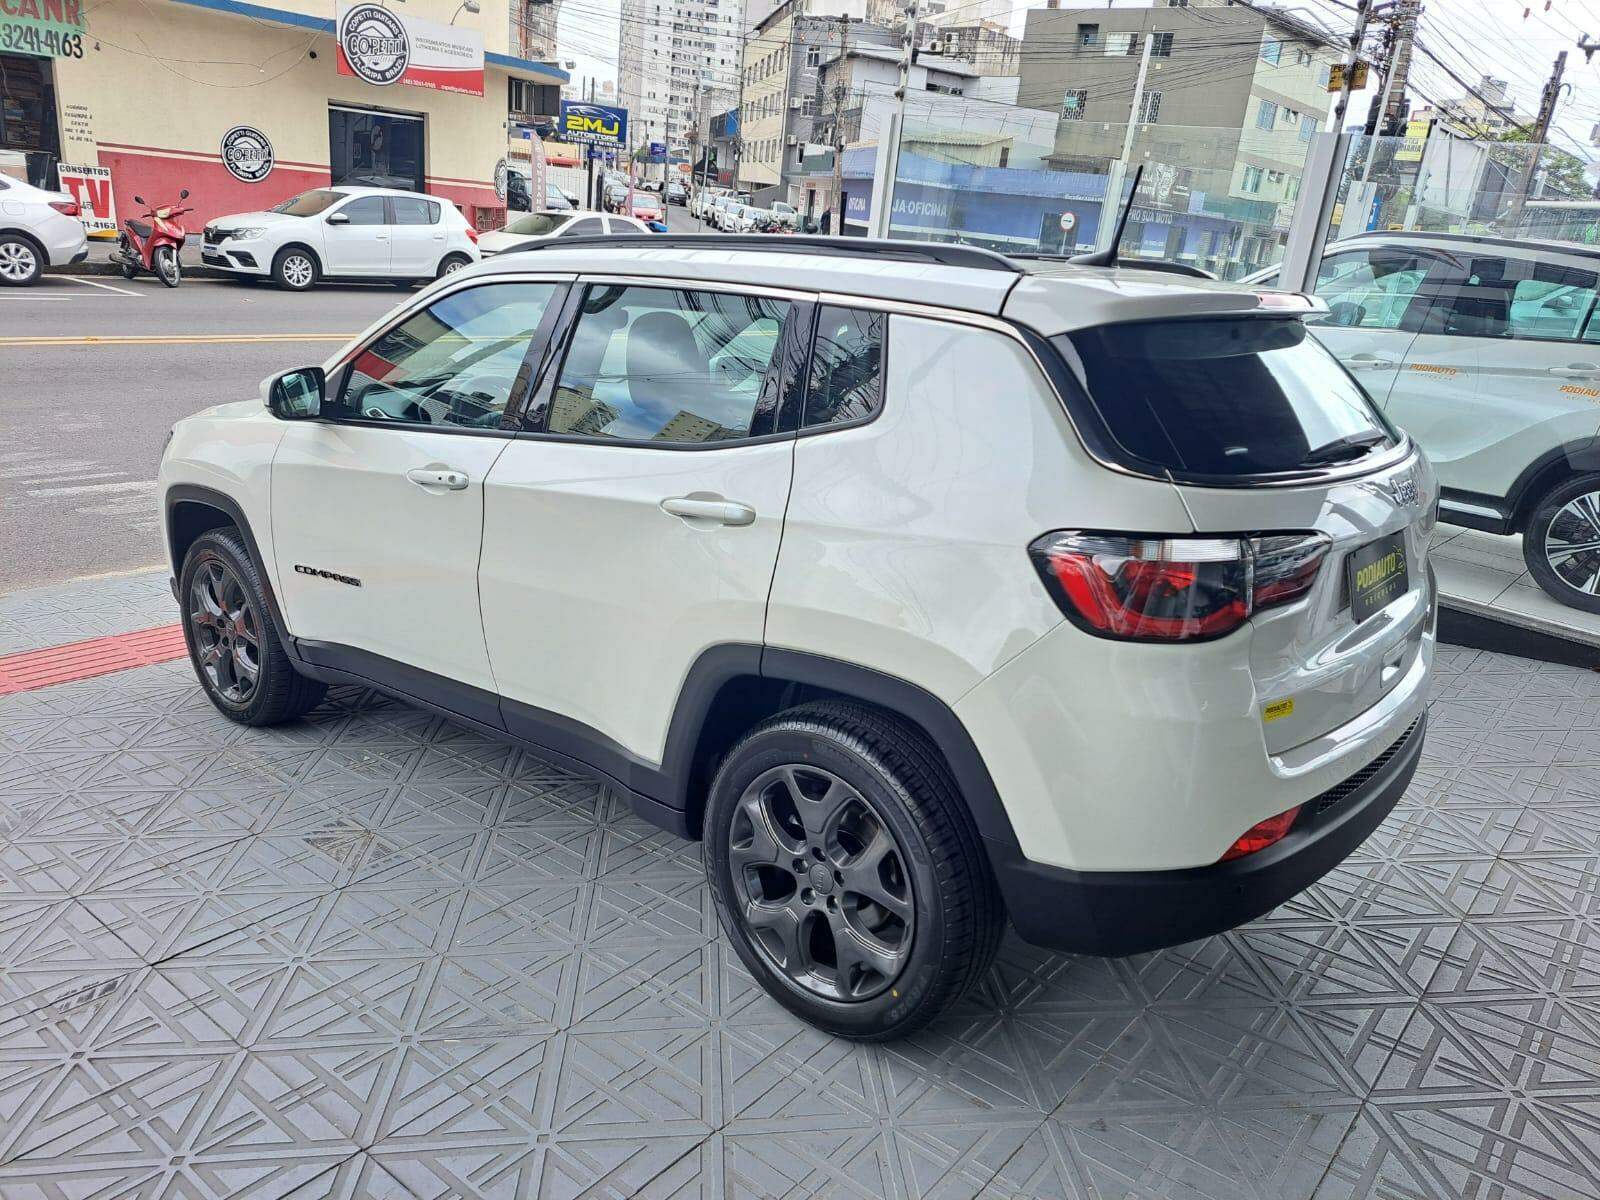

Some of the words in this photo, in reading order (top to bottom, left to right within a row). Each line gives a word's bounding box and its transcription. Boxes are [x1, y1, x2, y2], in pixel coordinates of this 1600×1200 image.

[348, 33, 403, 57] COPETTI
[566, 115, 619, 136] 2MJ
[59, 164, 109, 177] CONSERTOS
[62, 176, 110, 219] TV
[908, 200, 947, 217] OFICINA
[1410, 363, 1457, 376] PODIAUTO
[294, 565, 362, 588] COMPASS
[1357, 553, 1396, 593] PODIAUTO
